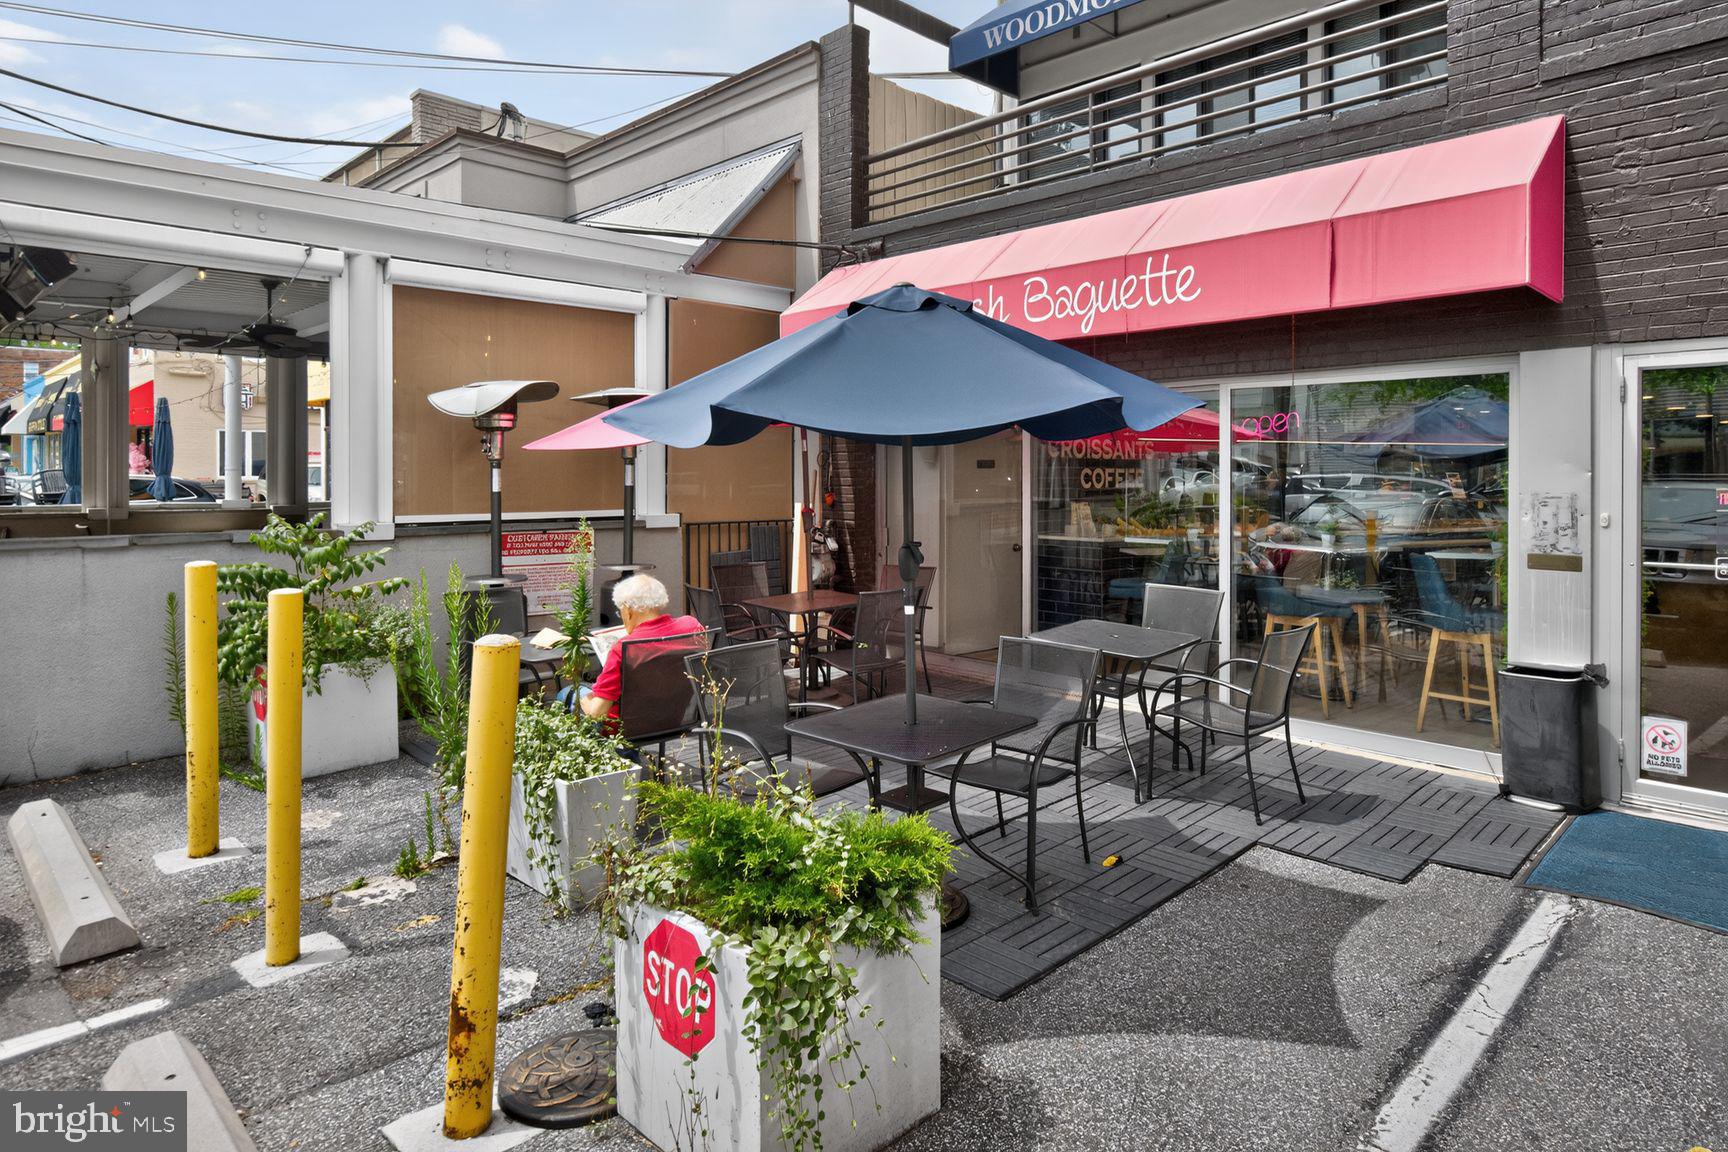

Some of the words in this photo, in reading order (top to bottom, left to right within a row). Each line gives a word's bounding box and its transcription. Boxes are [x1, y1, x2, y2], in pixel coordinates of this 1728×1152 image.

[1023, 253, 1201, 334] Baguette
[1242, 411, 1299, 441] open
[1047, 439, 1154, 460] CROISSANTS
[1081, 467, 1145, 489] COFFEE
[646, 950, 712, 1024] STOP
